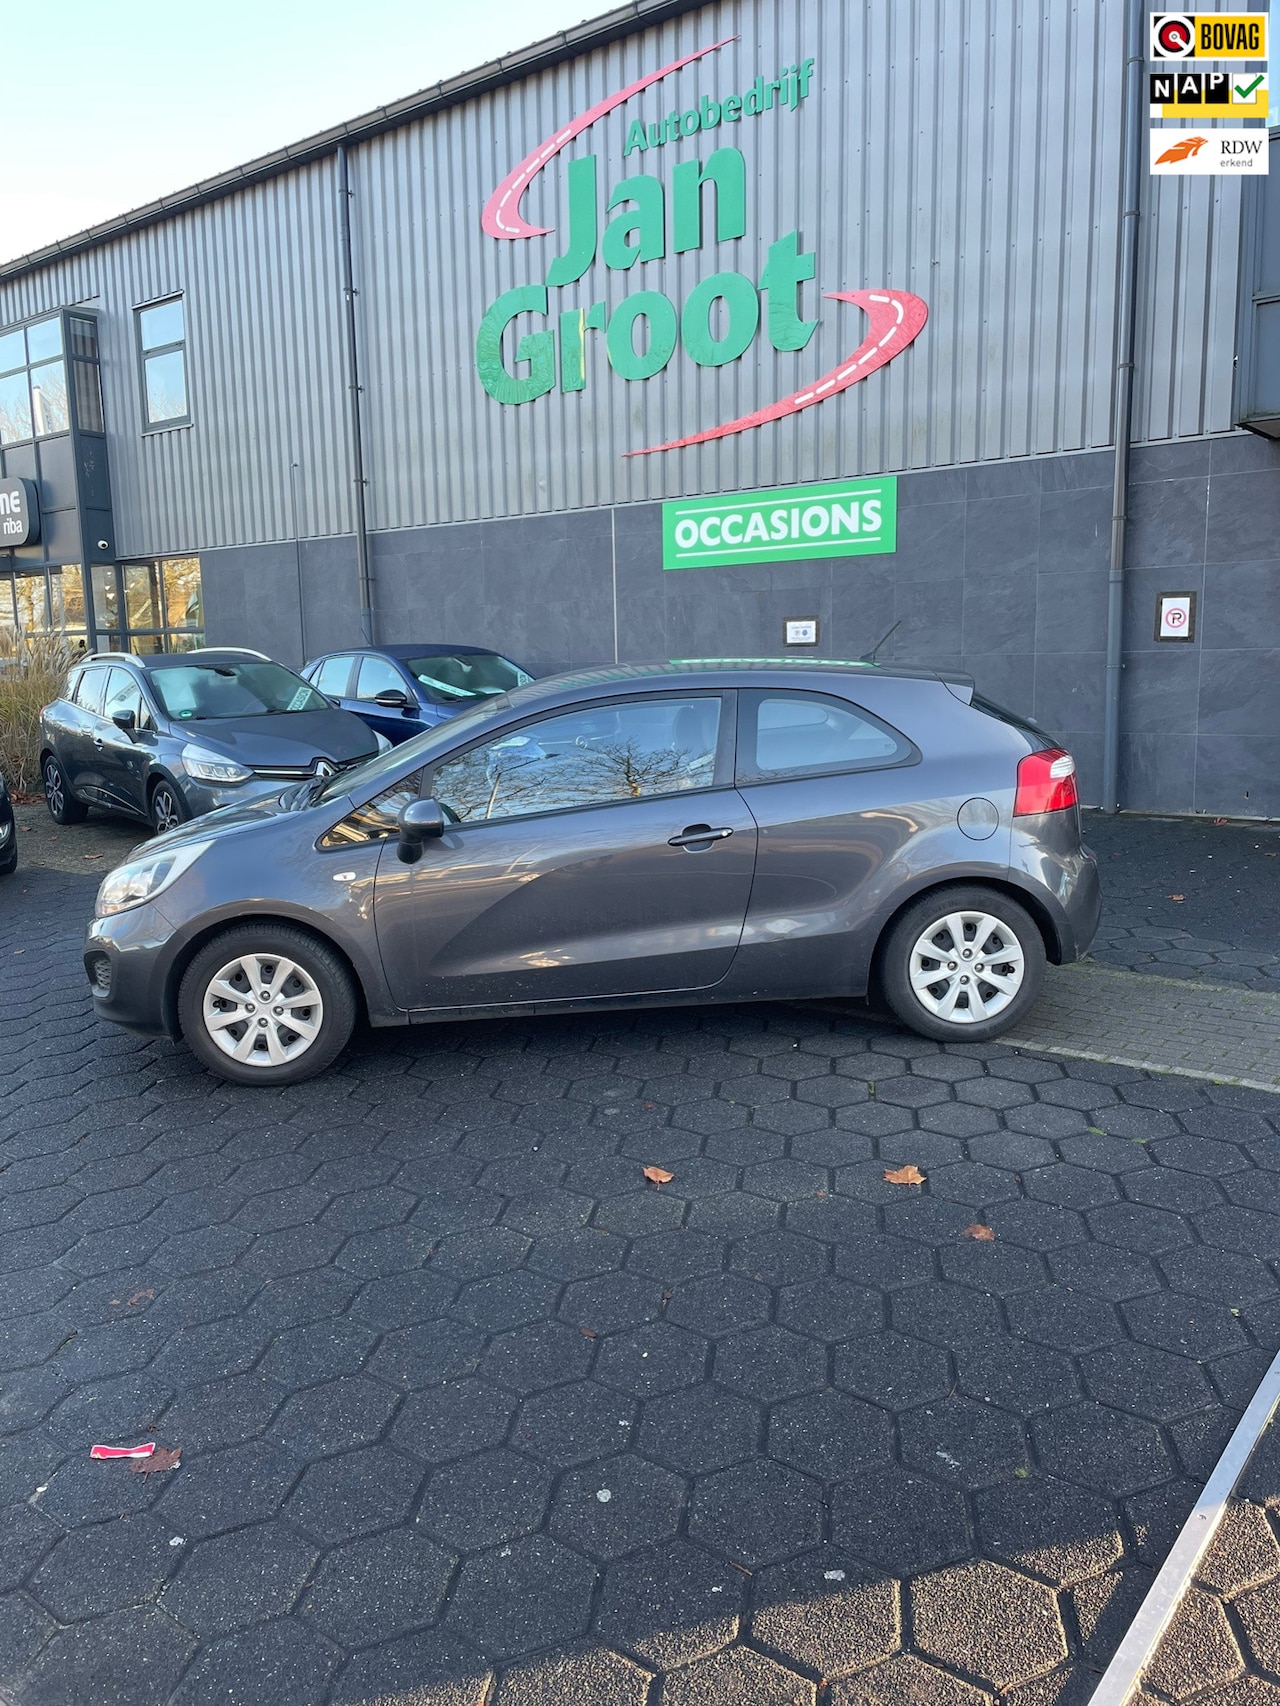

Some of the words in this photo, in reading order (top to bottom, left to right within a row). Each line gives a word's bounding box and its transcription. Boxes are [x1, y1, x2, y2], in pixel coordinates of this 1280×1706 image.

[623, 57, 815, 157] Autobedrijf
[546, 147, 746, 288] Jan
[476, 229, 819, 405] Groot
[674, 499, 882, 549] OCCASIONS
